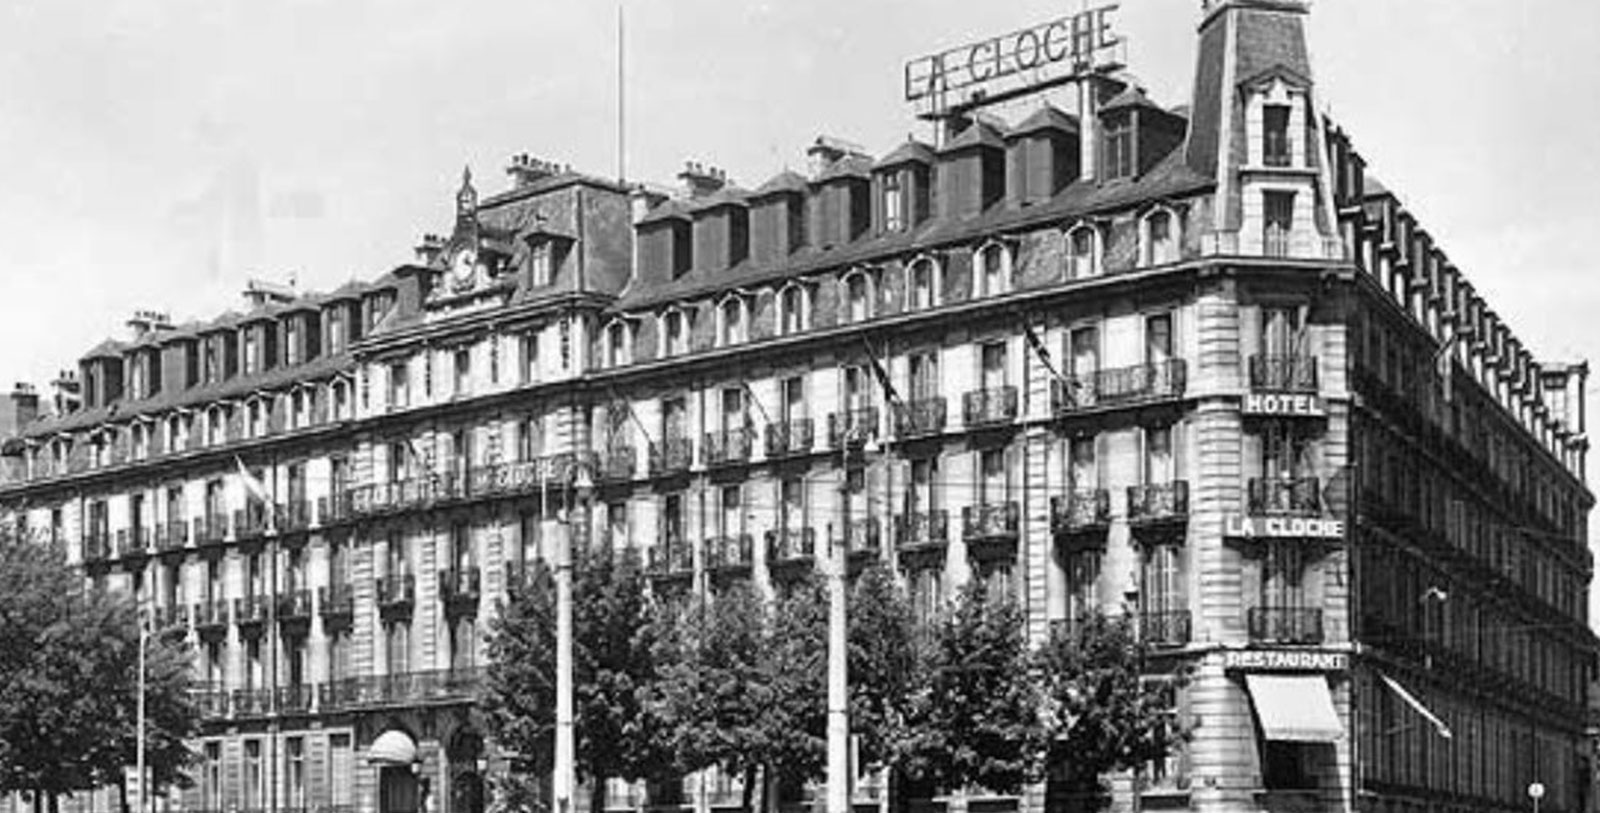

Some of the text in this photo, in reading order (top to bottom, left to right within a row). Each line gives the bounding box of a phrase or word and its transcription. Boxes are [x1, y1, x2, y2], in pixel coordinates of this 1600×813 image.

[905, 4, 1119, 101] LA CLOCHE
[1246, 394, 1324, 415] HOTEL
[1226, 517, 1344, 537] LA CLOCHE
[1226, 652, 1346, 670] RESTAURANT
